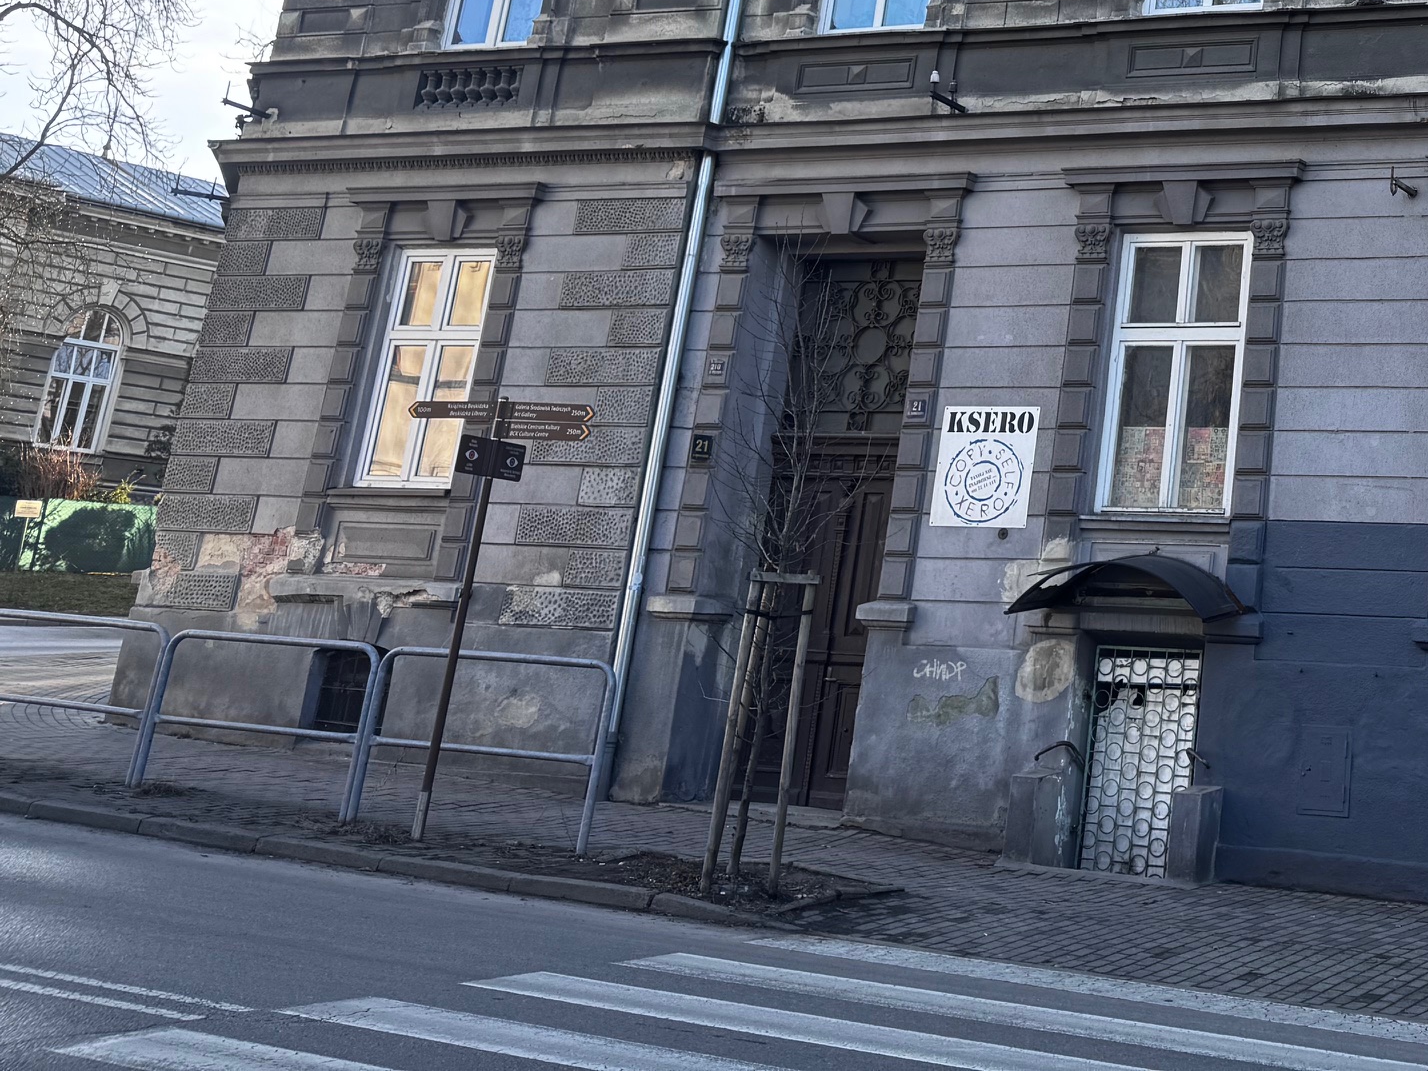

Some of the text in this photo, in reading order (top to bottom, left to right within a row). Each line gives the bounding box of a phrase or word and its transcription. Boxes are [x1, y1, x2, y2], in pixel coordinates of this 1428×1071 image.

[912, 400, 921, 411] 21
[947, 411, 1035, 433] KSERO
[695, 439, 708, 452] 21
[950, 444, 986, 487] COPY
[995, 448, 1016, 490] SELF
[955, 495, 1005, 518] XERO
